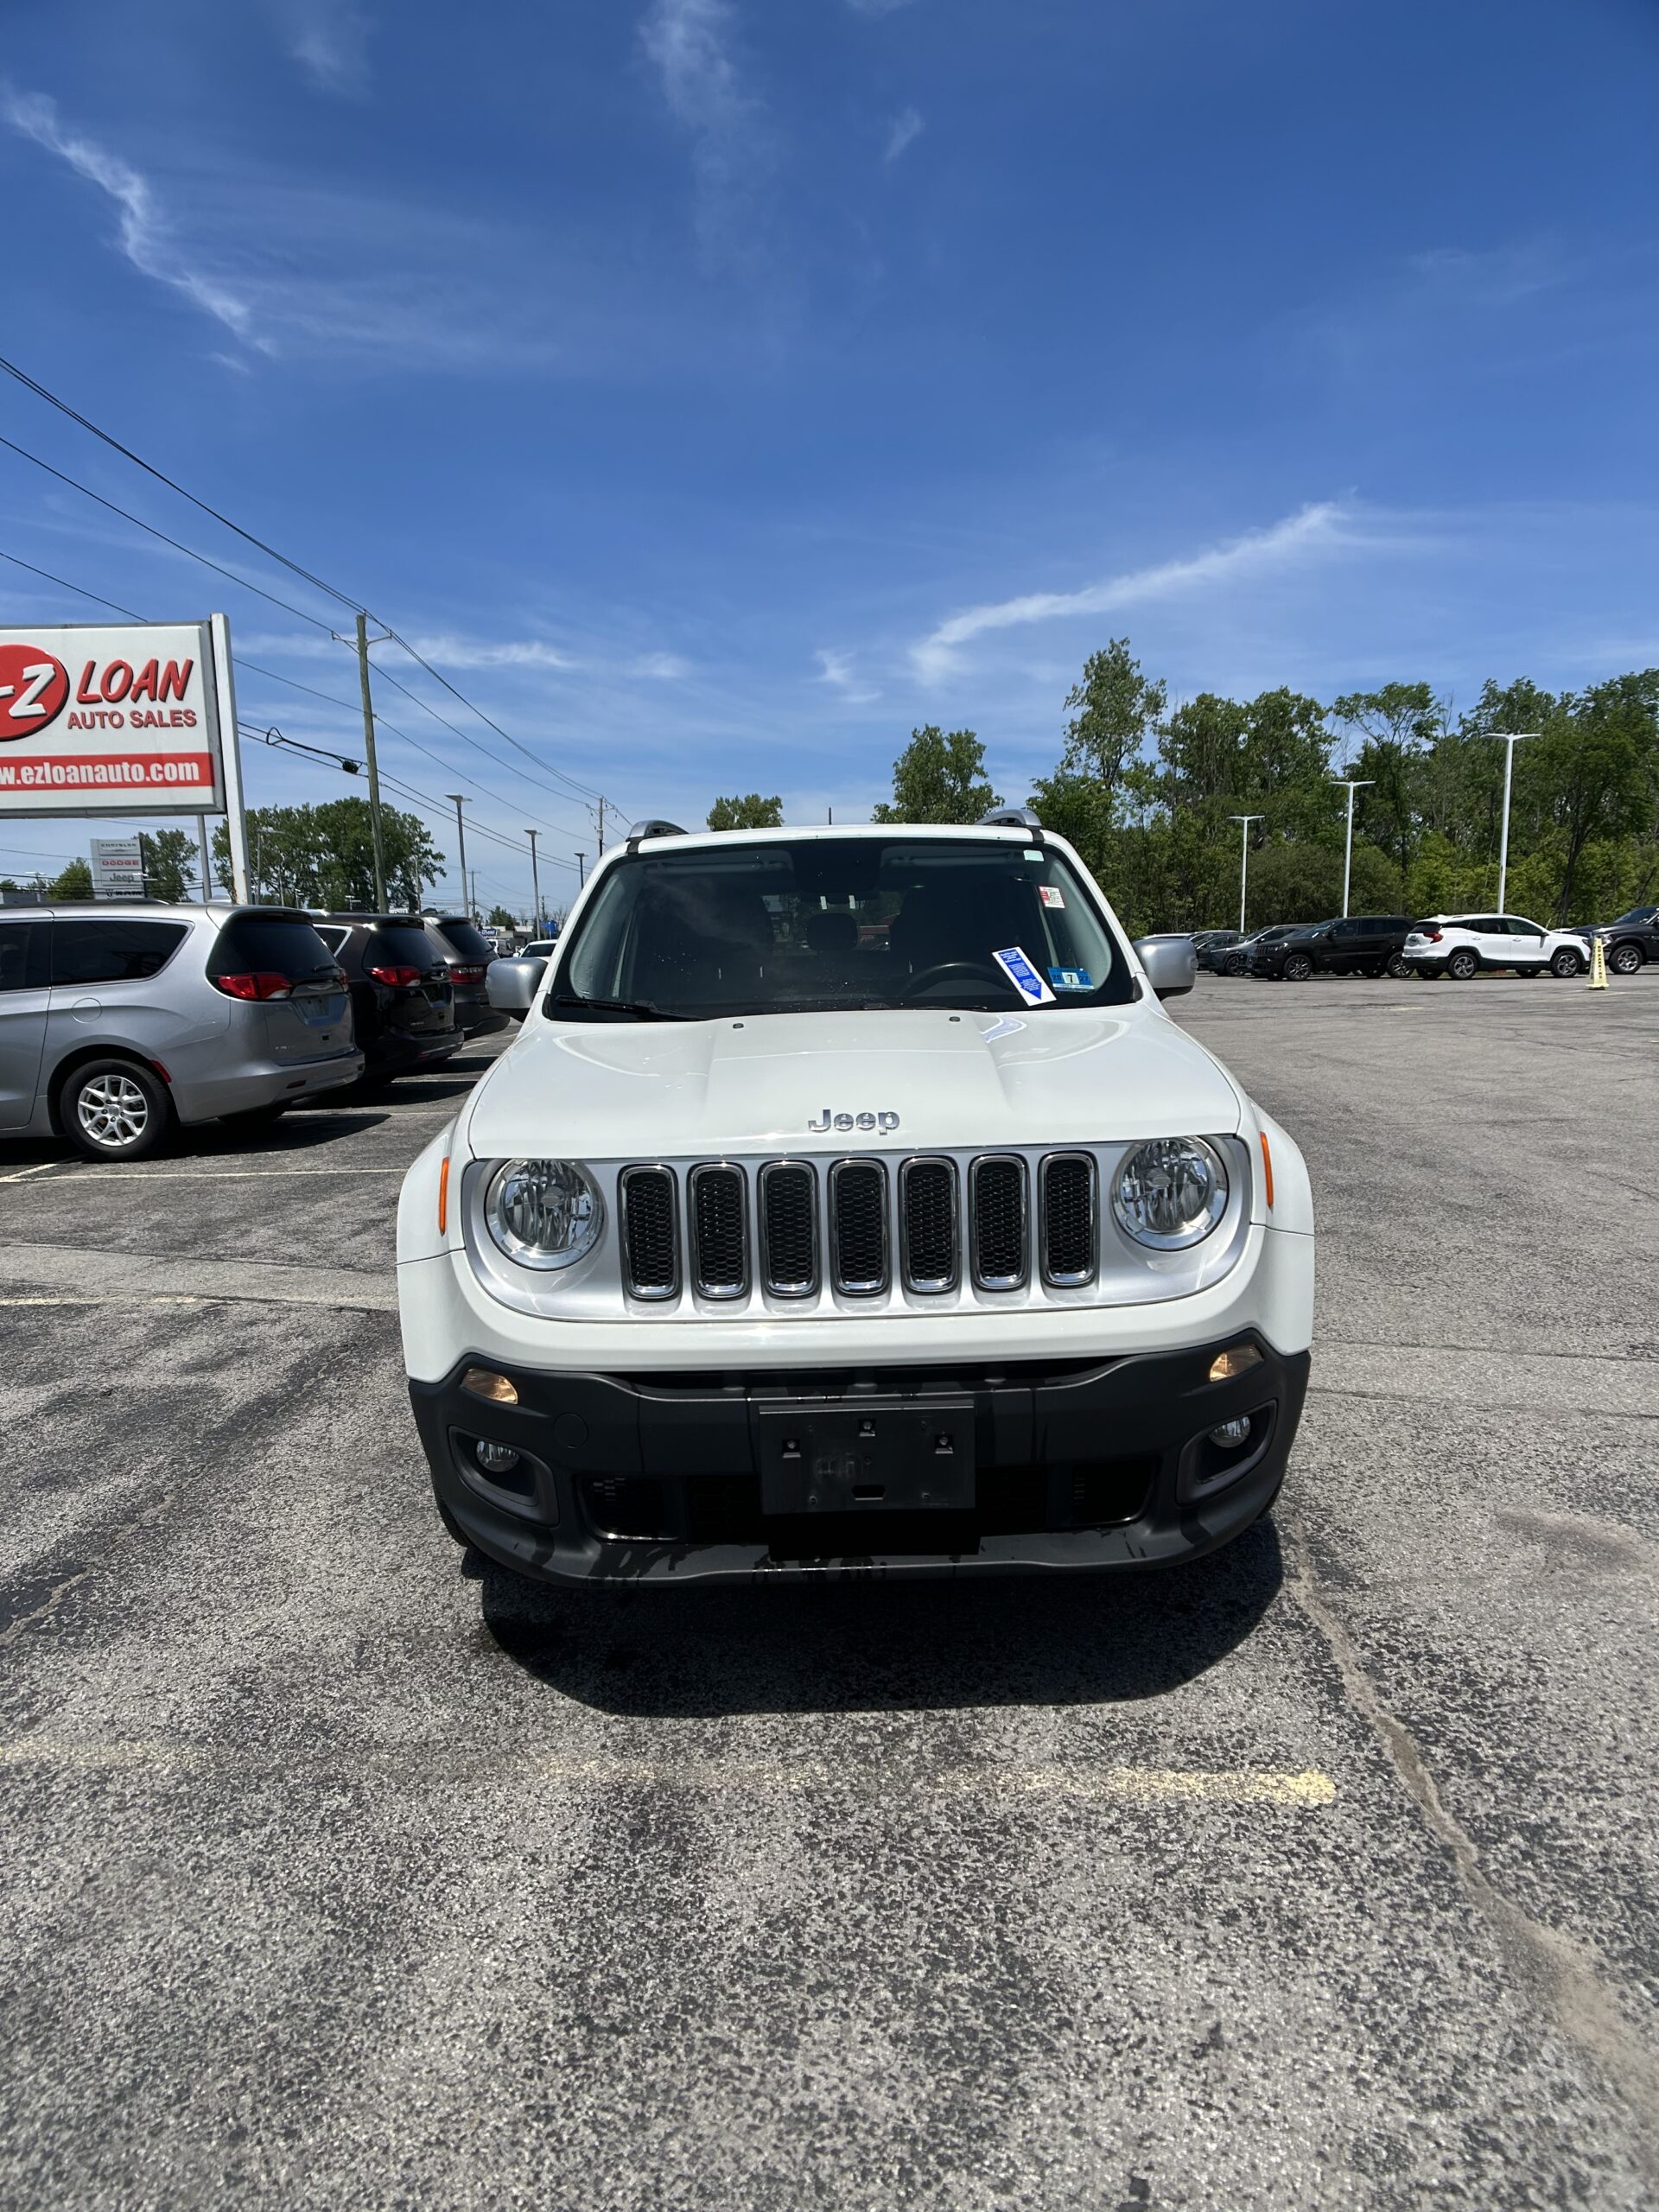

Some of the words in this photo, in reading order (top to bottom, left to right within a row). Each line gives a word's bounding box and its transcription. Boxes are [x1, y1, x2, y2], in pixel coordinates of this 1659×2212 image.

[76, 657, 194, 704] LOAN
[67, 710, 124, 729] AUTO
[130, 709, 197, 728] SALES
[110, 873, 135, 883] Jeep
[1066, 974, 1073, 983] 7
[808, 1109, 900, 1136] Jeep
